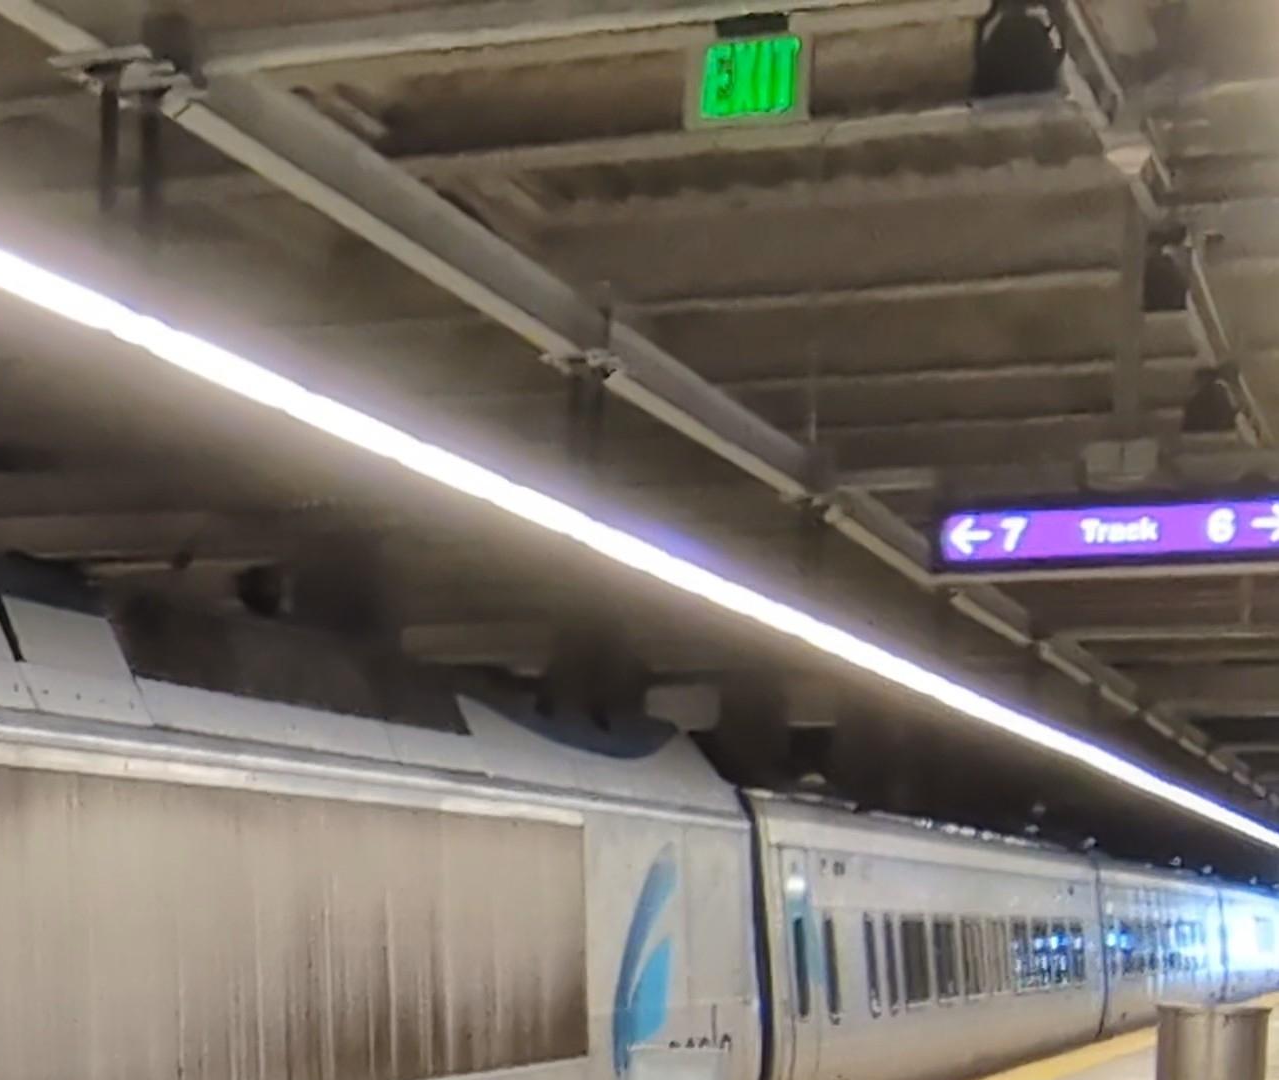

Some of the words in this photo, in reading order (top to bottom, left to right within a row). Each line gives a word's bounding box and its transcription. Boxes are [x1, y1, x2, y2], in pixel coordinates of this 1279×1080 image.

[701, 36, 802, 117] EXIT
[999, 516, 1028, 552] 7
[1080, 517, 1159, 544] Track
[1206, 507, 1236, 543] 6
